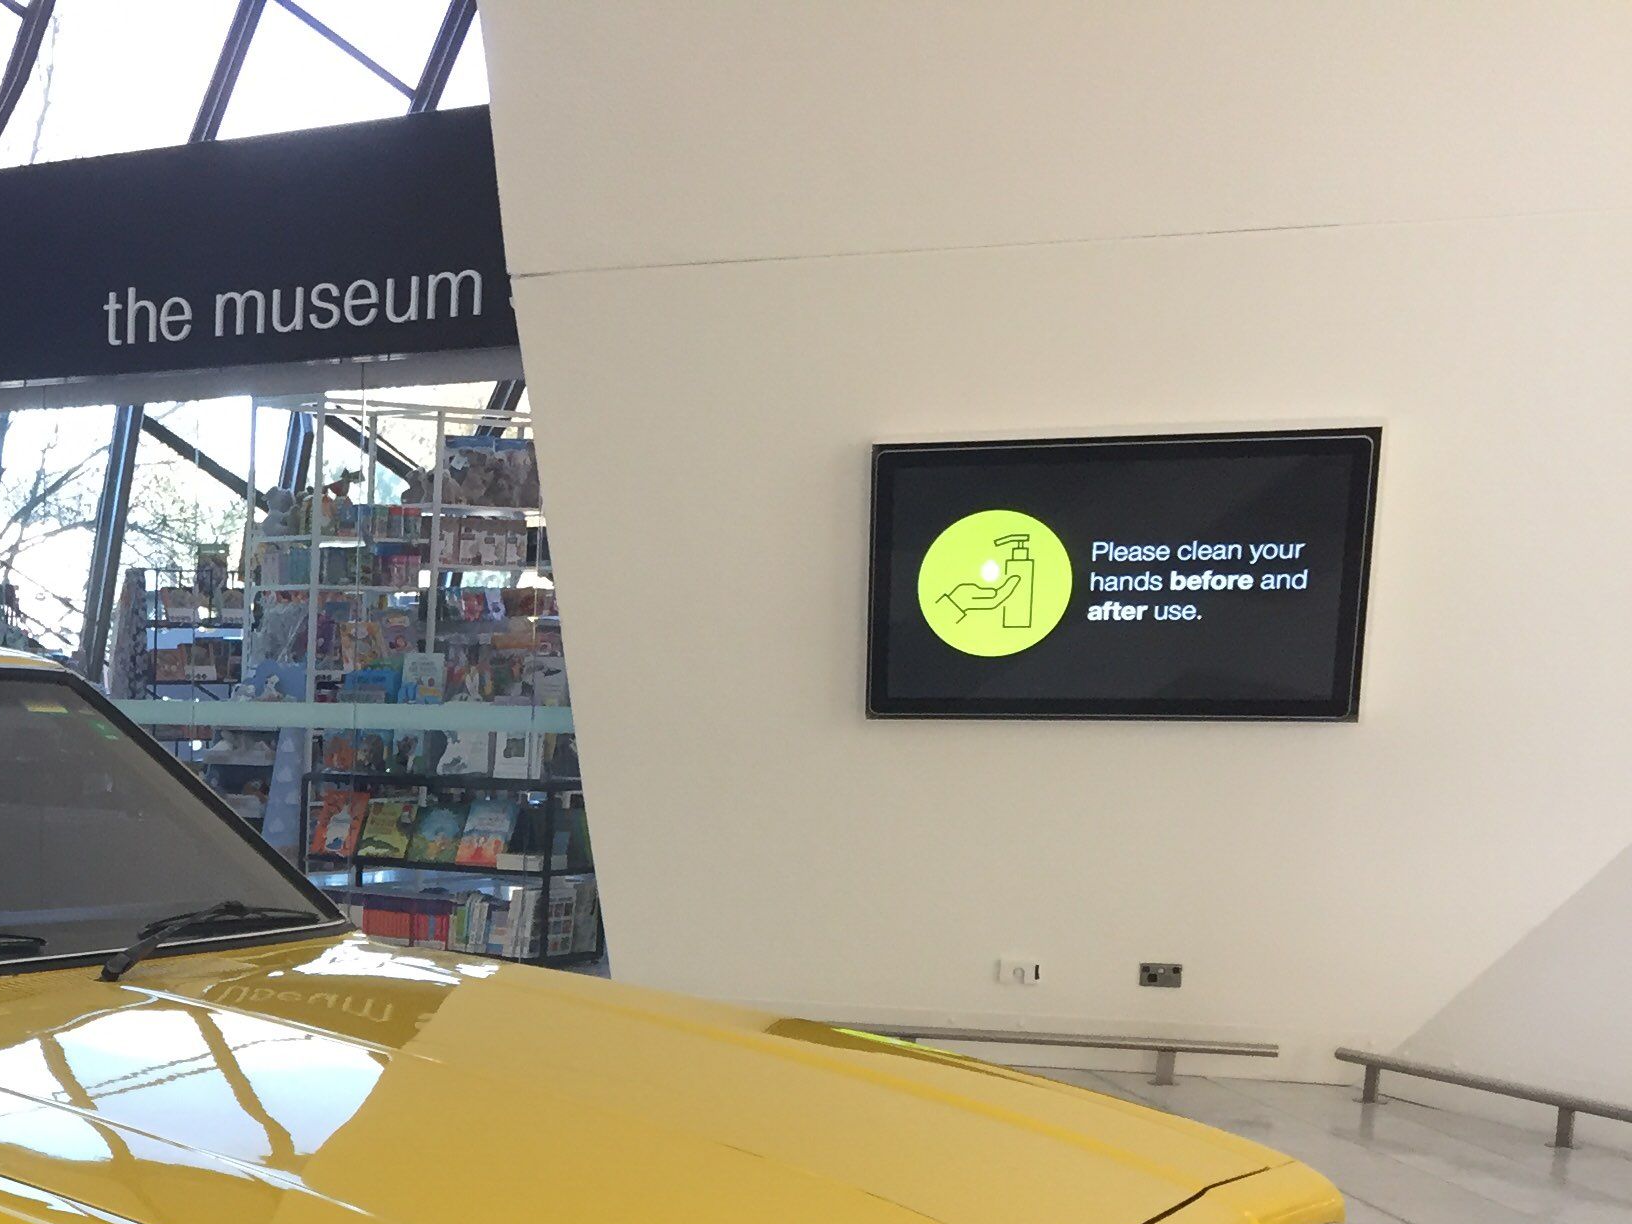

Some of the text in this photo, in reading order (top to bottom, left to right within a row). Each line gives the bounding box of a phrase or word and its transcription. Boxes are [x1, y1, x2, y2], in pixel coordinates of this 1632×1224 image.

[103, 269, 482, 346] the museum
[1091, 540, 1306, 565] Please clean your
[1089, 568, 1309, 592] hands before and
[1086, 600, 1203, 622] after use.
